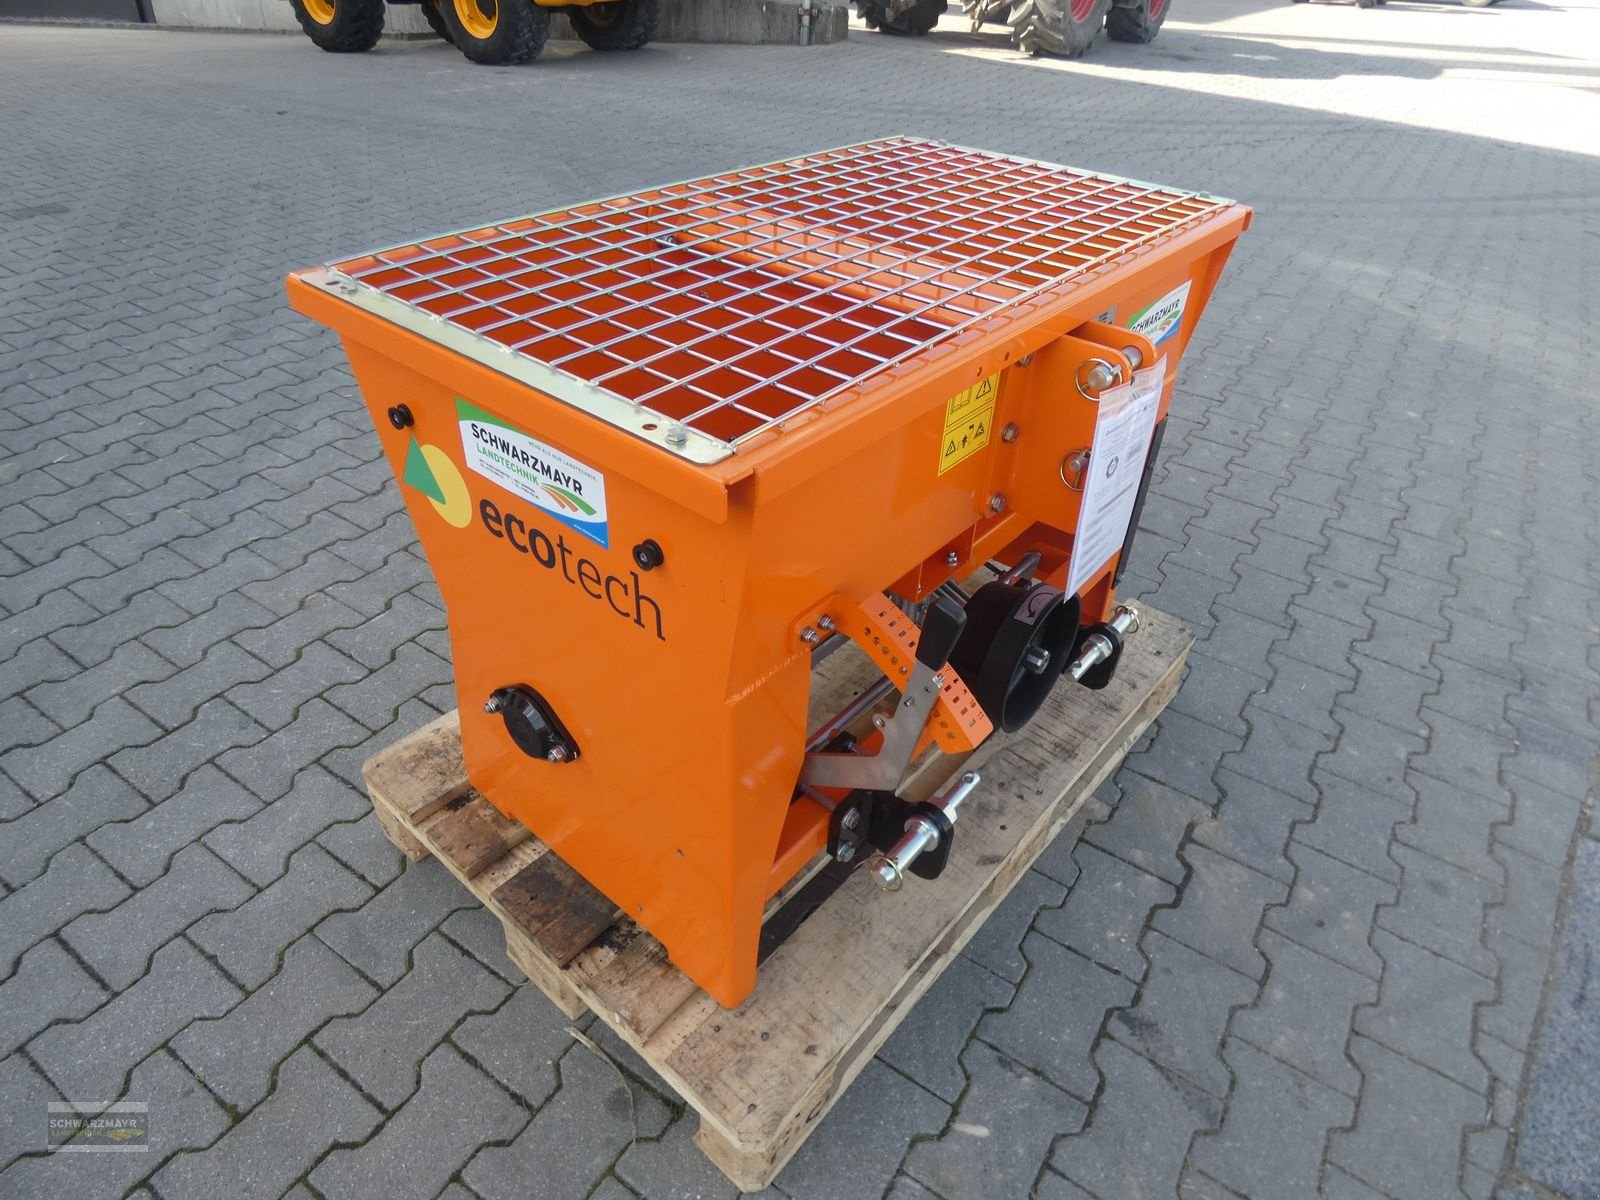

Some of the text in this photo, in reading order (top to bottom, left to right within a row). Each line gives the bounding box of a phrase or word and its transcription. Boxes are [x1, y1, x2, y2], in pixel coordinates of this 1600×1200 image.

[471, 423, 583, 497] SCHWARZMAYR
[476, 443, 539, 486] LANDTECHNIK
[479, 498, 666, 642] ecotech
